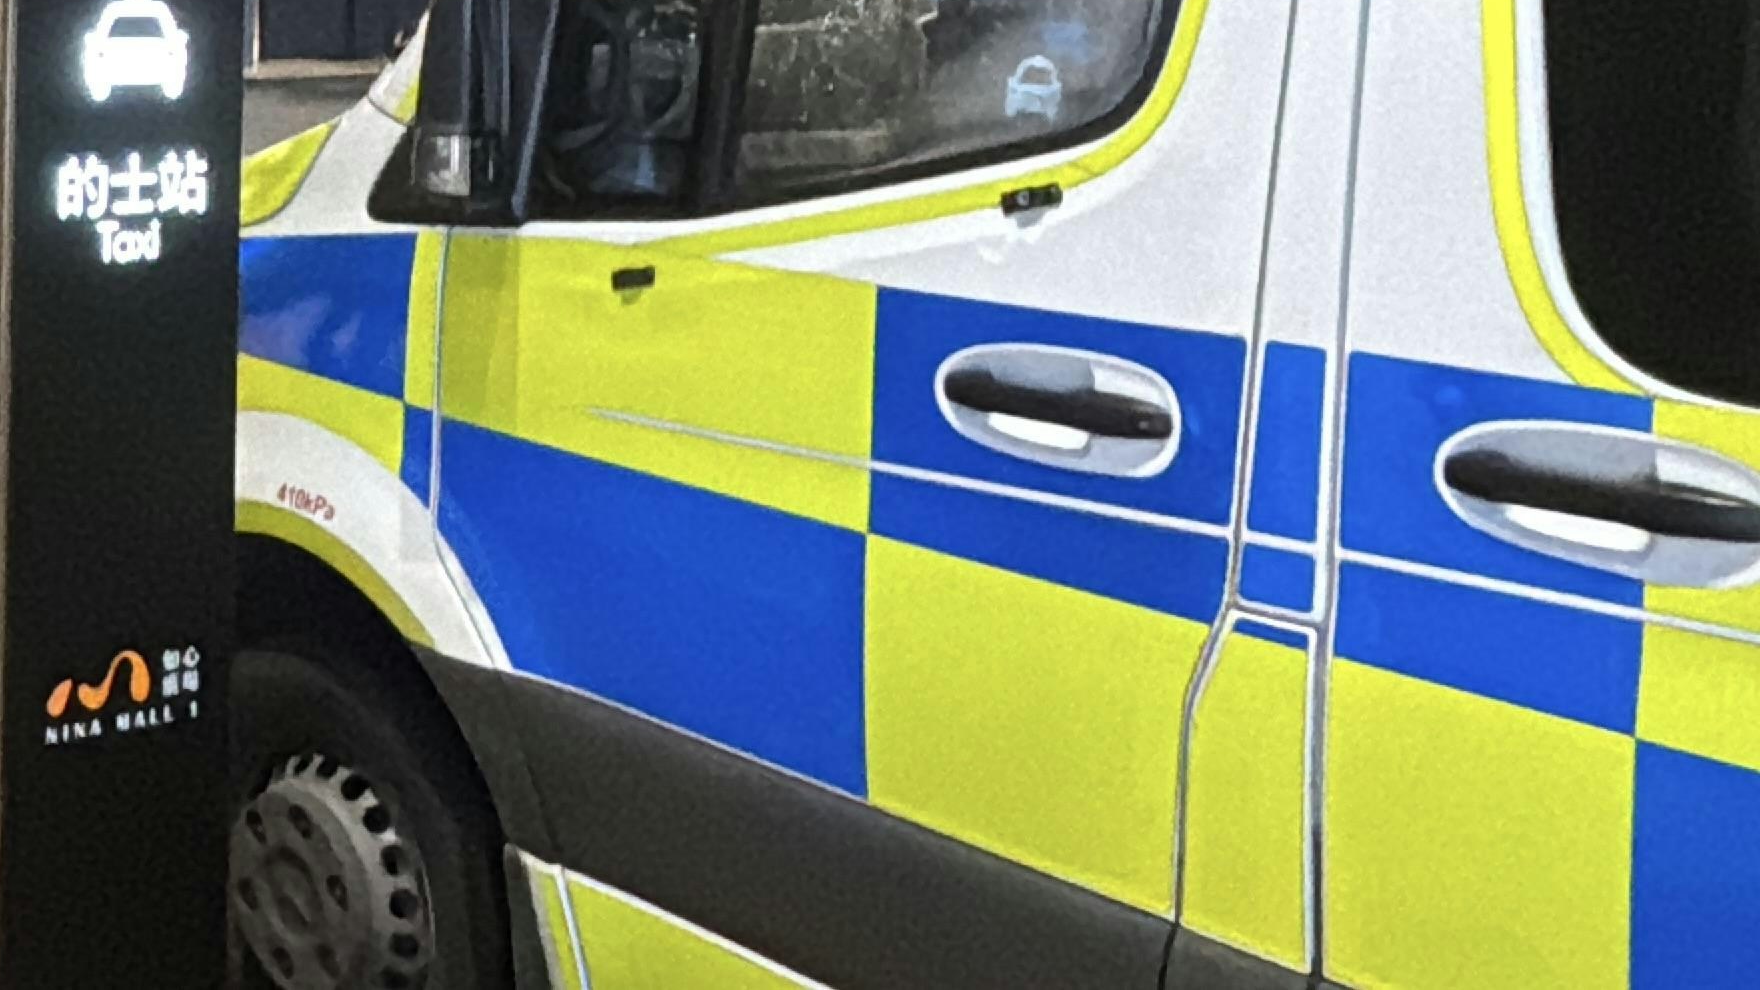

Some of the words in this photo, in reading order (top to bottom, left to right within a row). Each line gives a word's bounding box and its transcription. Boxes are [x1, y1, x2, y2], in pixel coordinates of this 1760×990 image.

[56, 150, 208, 220] 的士站
[97, 218, 161, 264] Taxi
[45, 718, 102, 746] NINA
[115, 704, 175, 732] MALL
